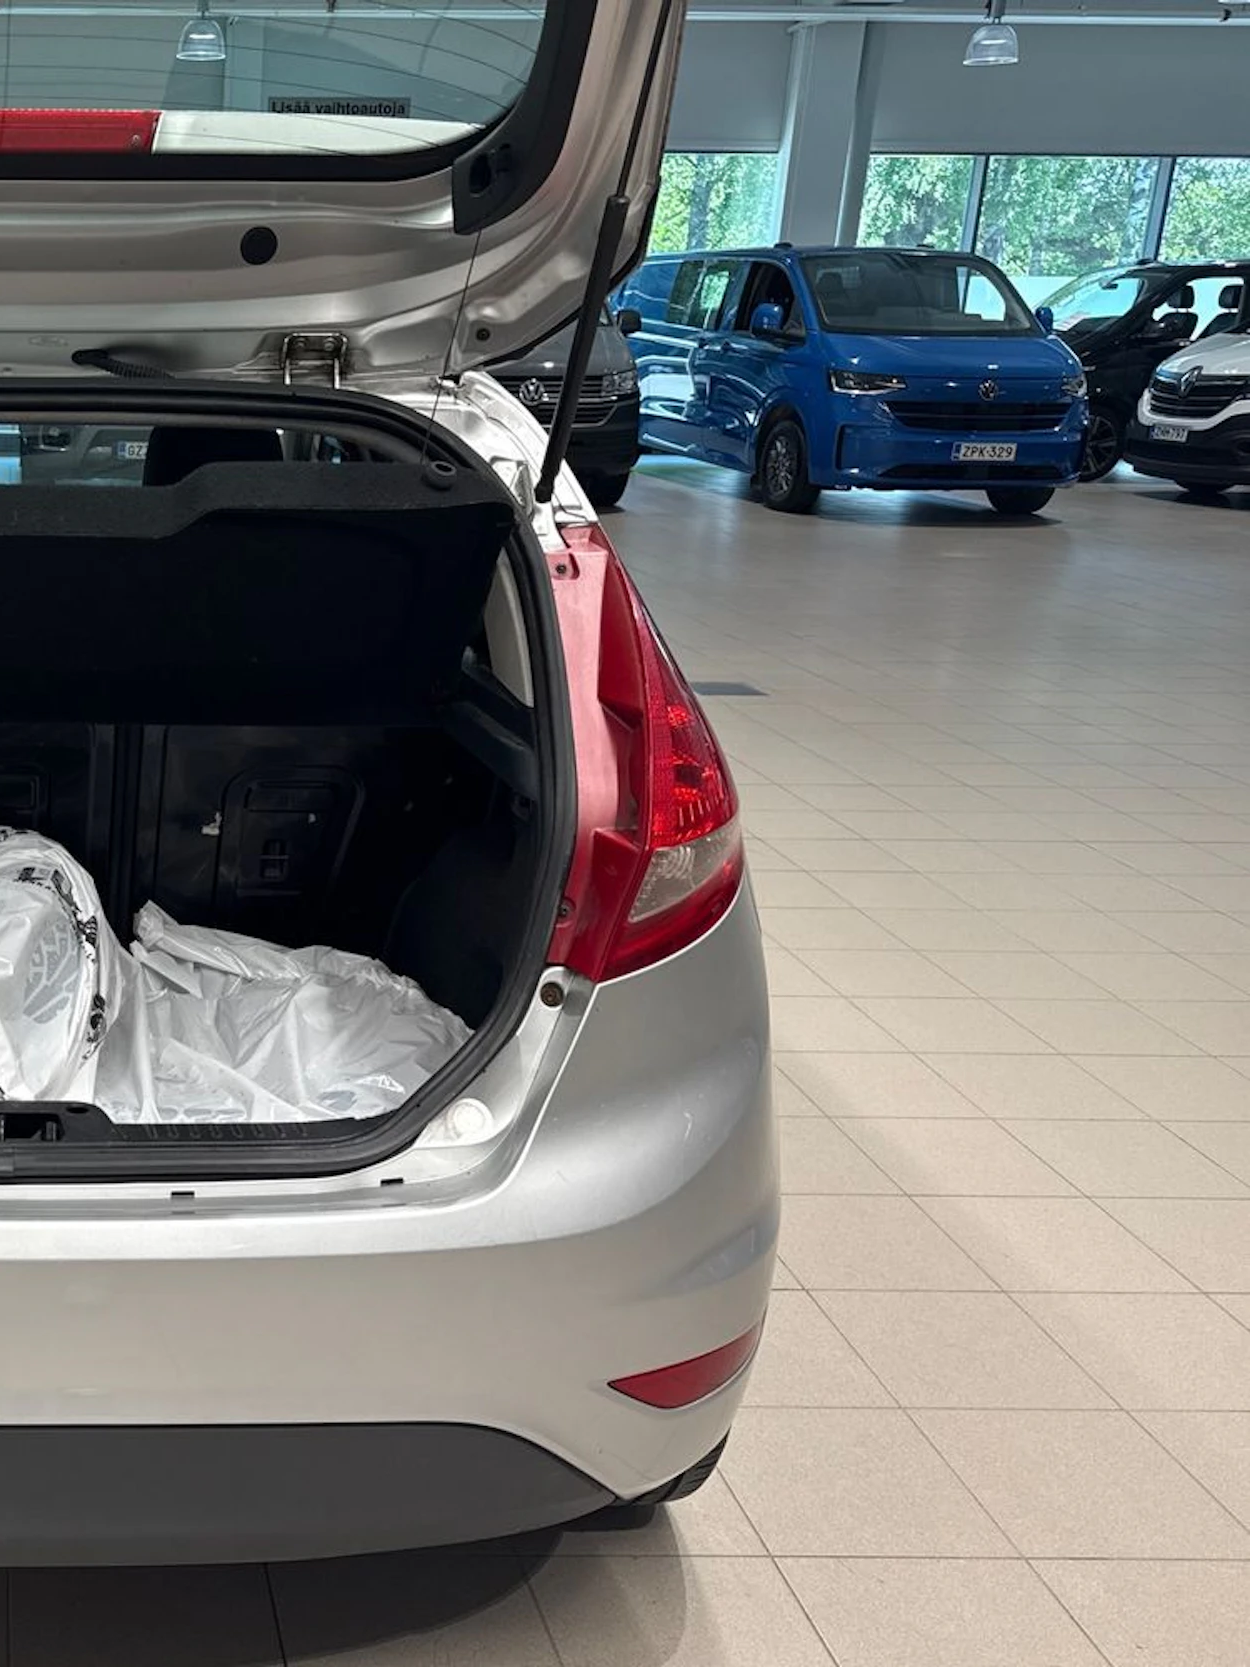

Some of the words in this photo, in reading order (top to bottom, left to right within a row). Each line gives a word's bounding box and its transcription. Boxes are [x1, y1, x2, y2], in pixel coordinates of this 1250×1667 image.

[272, 101, 311, 114] Lisää
[315, 101, 406, 116] vaihtoautoja
[963, 446, 1013, 458] ZPK-329
